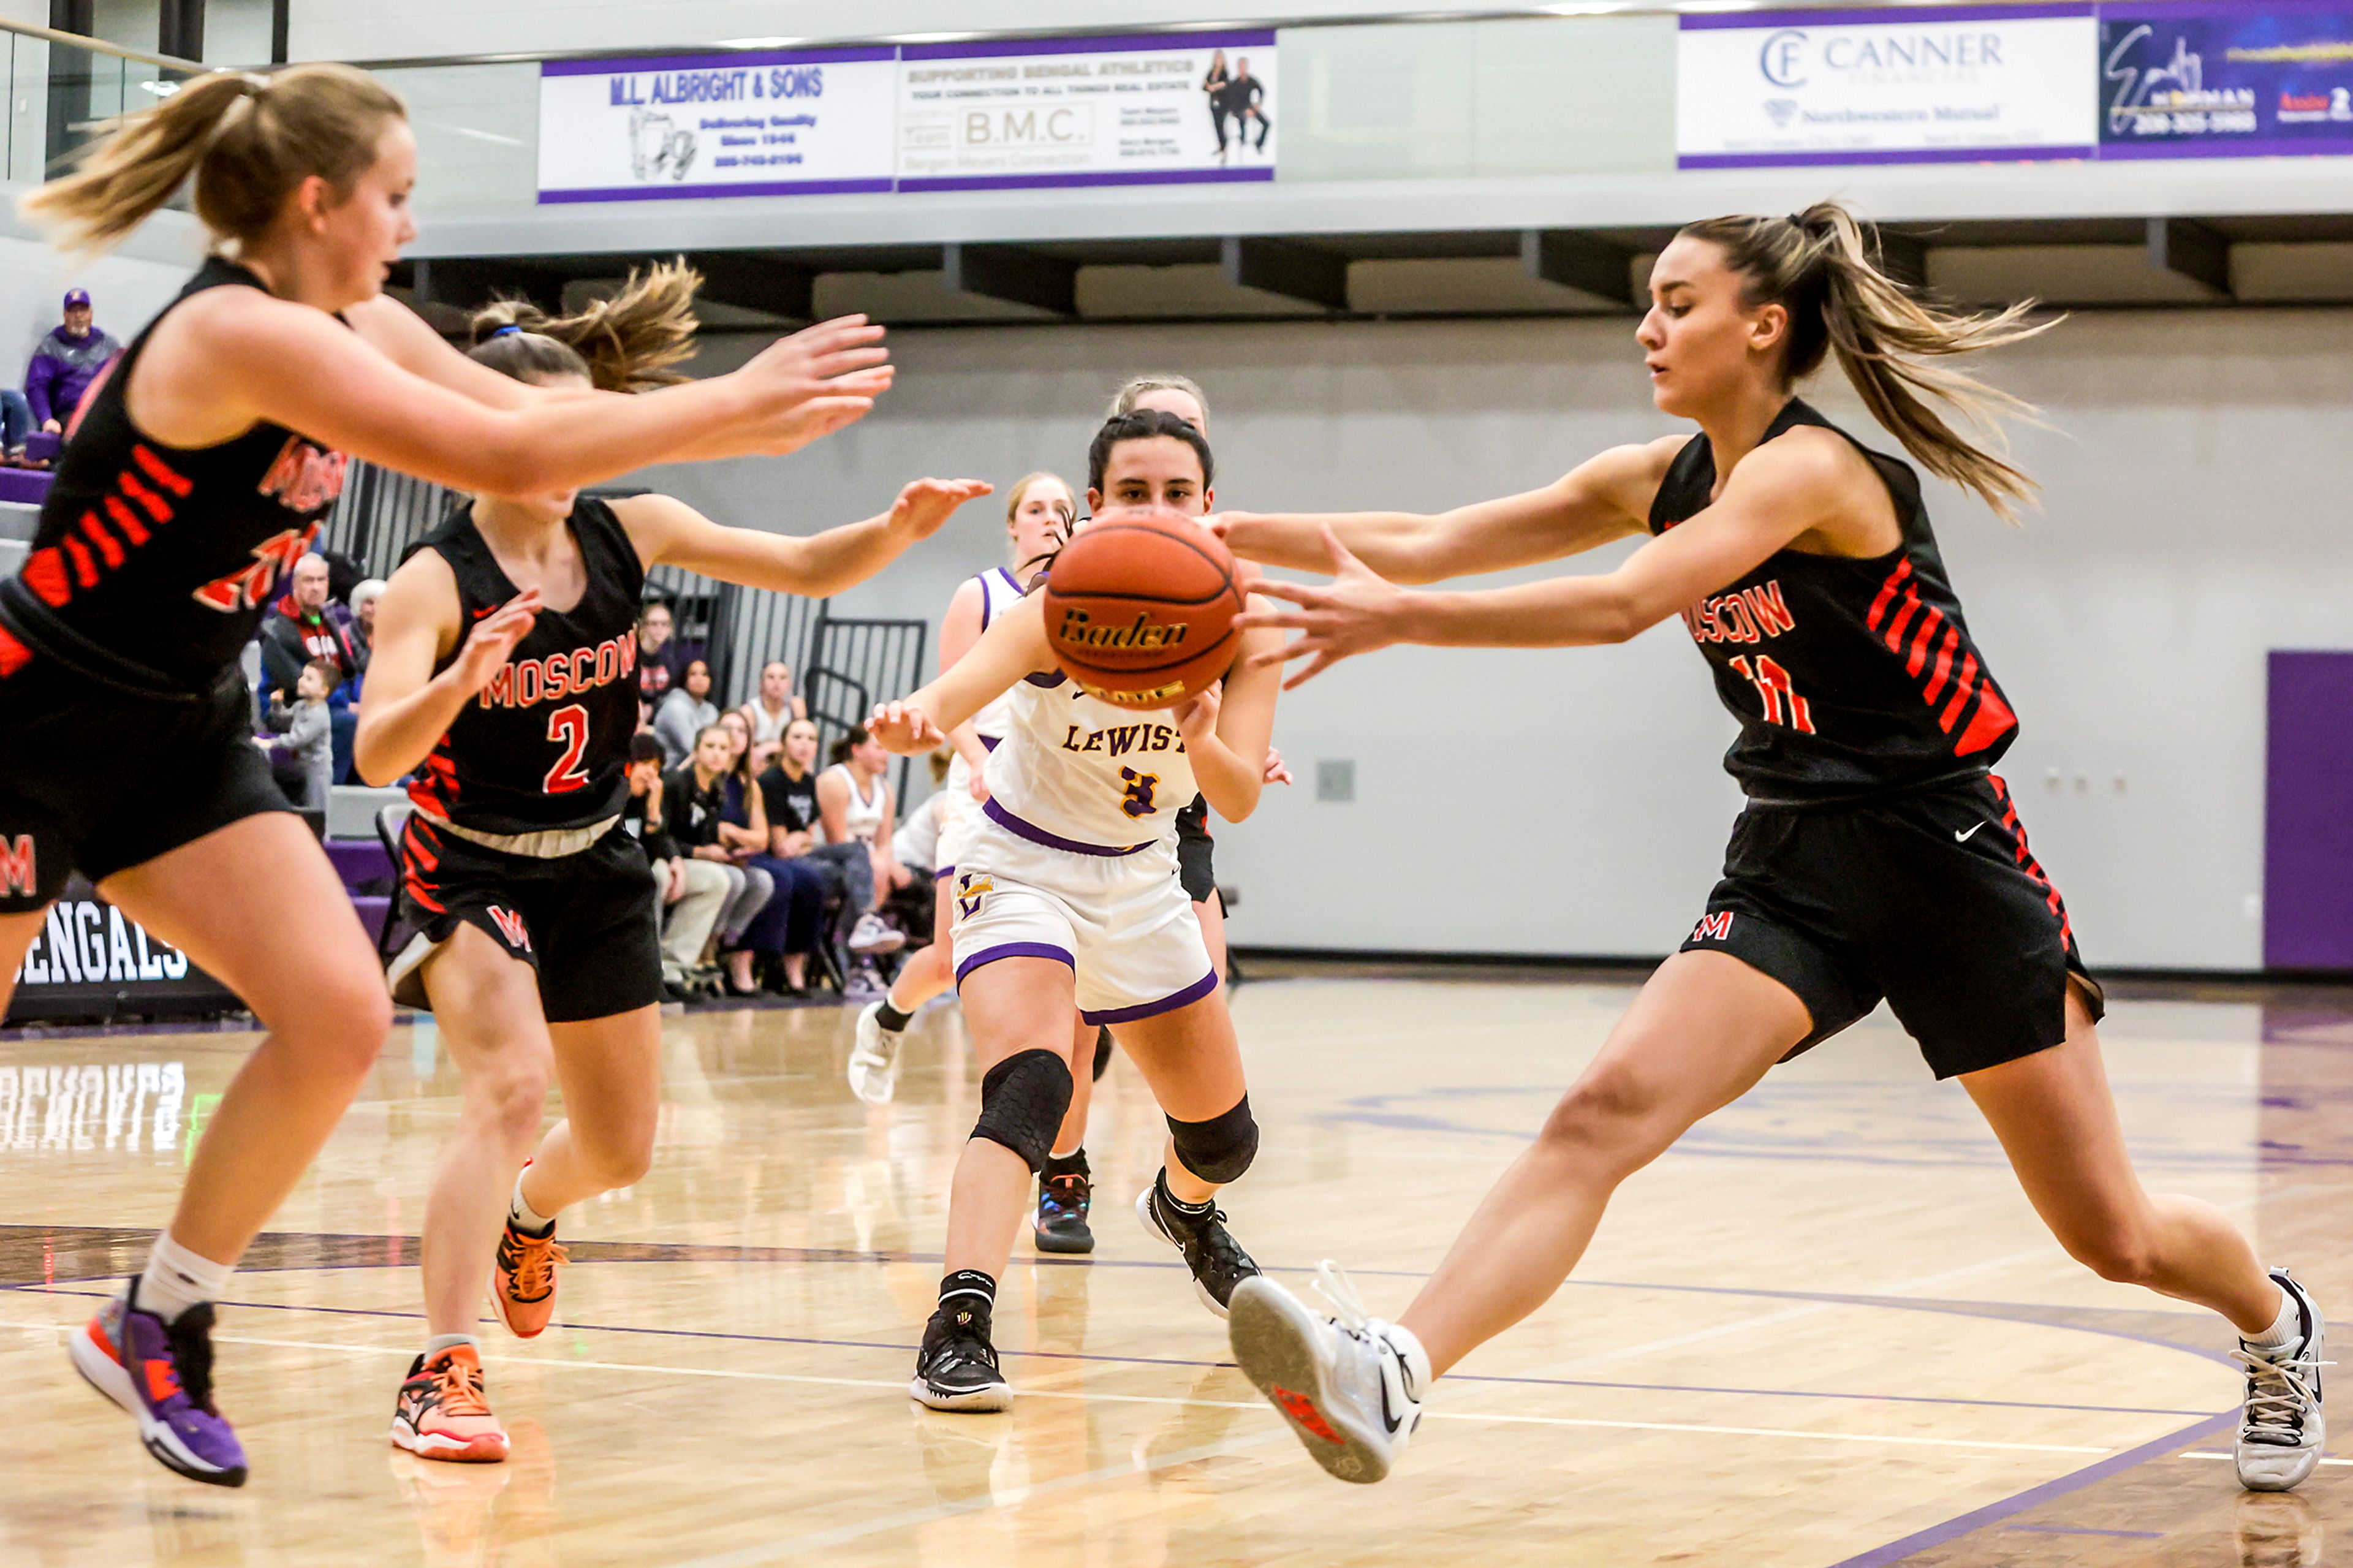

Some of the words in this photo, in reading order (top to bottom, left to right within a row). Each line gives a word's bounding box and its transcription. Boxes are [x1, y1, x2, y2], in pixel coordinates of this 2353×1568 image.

[1824, 33, 2003, 69] CANNER
[651, 71, 748, 104] ALBRIGHT
[754, 72, 763, 98] &
[770, 67, 822, 99] SONS
[908, 66, 1017, 83] SUPPORTING
[1024, 63, 1090, 79] BENGAL
[1099, 59, 1194, 75] ATHLETICS
[946, 88, 1020, 97] CONNECTION
[1147, 81, 1189, 91] ESTATE
[1847, 69, 1980, 85] FINANCIAL
[966, 108, 1086, 144] B.M.C.
[1803, 106, 1928, 124] Northwestern
[1934, 102, 2003, 121] Mutual
[1059, 607, 1189, 649] Baden
[1681, 579, 1796, 643] OSCOW
[479, 629, 637, 710] MOSCOW
[542, 703, 589, 793] 2
[0, 834, 36, 896] M
[13, 901, 188, 984] ENGALS
[1692, 911, 1733, 942] M
